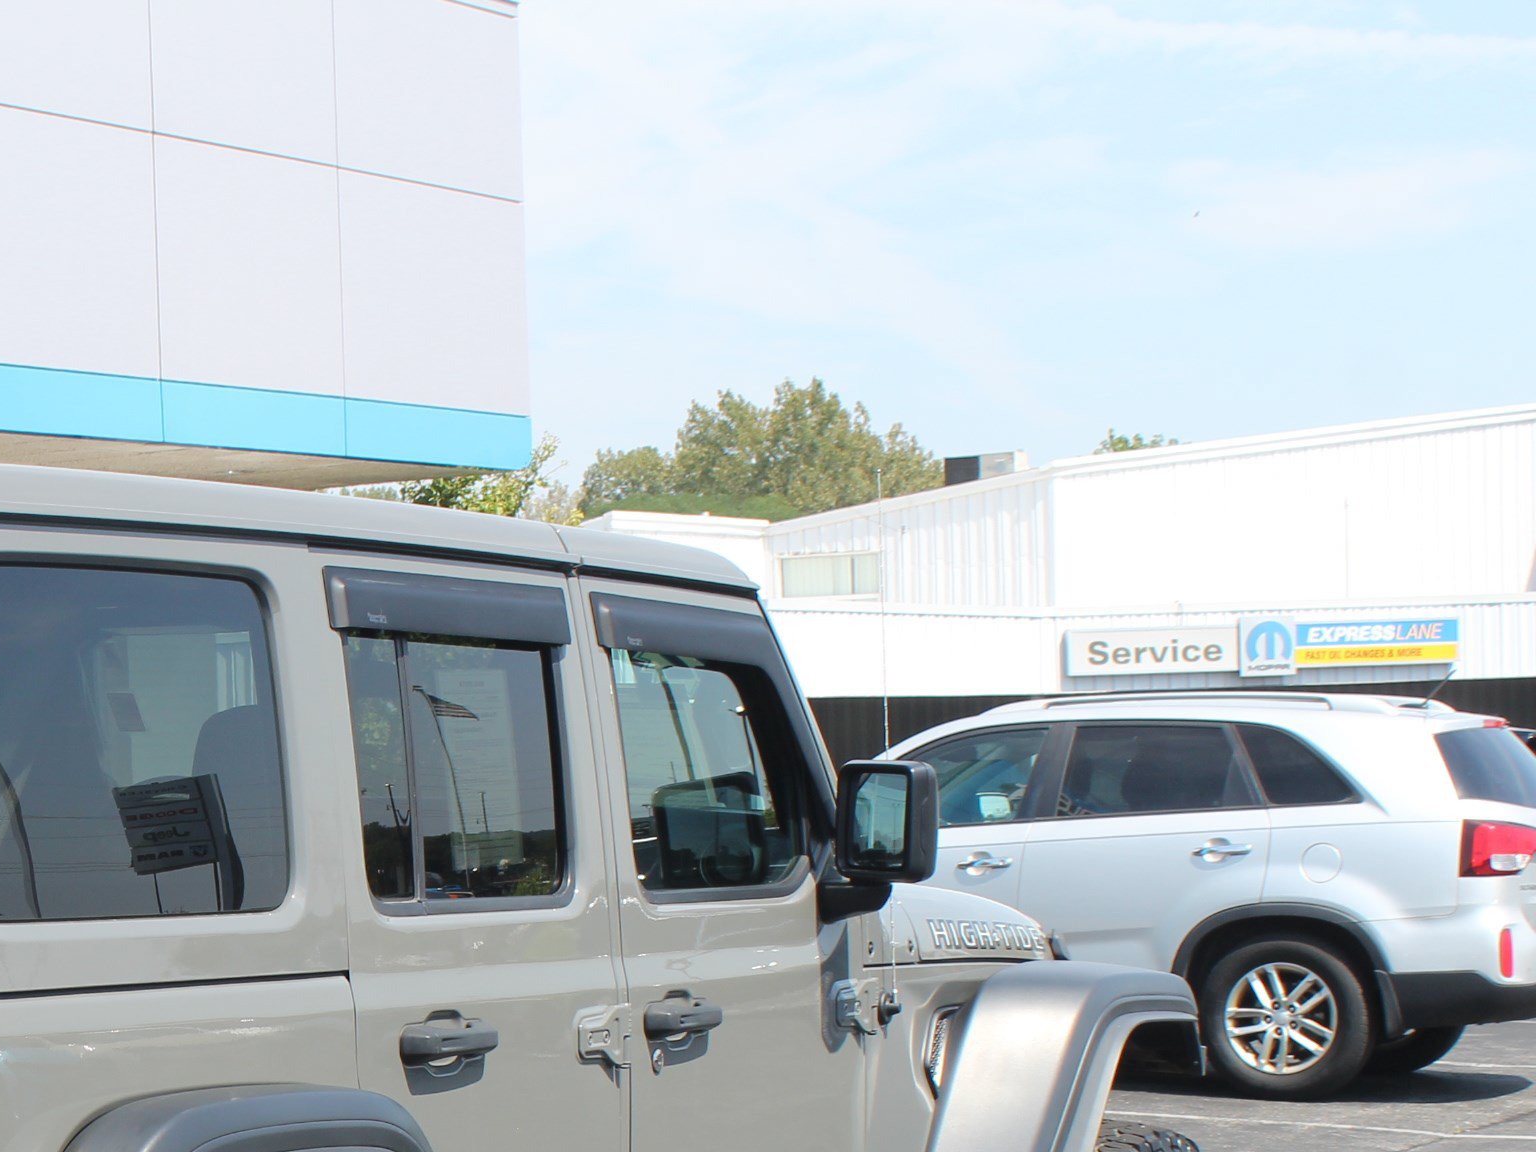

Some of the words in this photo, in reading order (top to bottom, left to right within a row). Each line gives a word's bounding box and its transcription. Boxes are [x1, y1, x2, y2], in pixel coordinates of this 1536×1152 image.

[1086, 638, 1224, 666] Service
[1305, 649, 1328, 660] FAST
[1328, 649, 1343, 660] OIL
[1344, 647, 1385, 659] CHANGES
[1388, 647, 1394, 657] &
[1397, 647, 1423, 657] MORE
[1247, 663, 1292, 672] MOPAR
